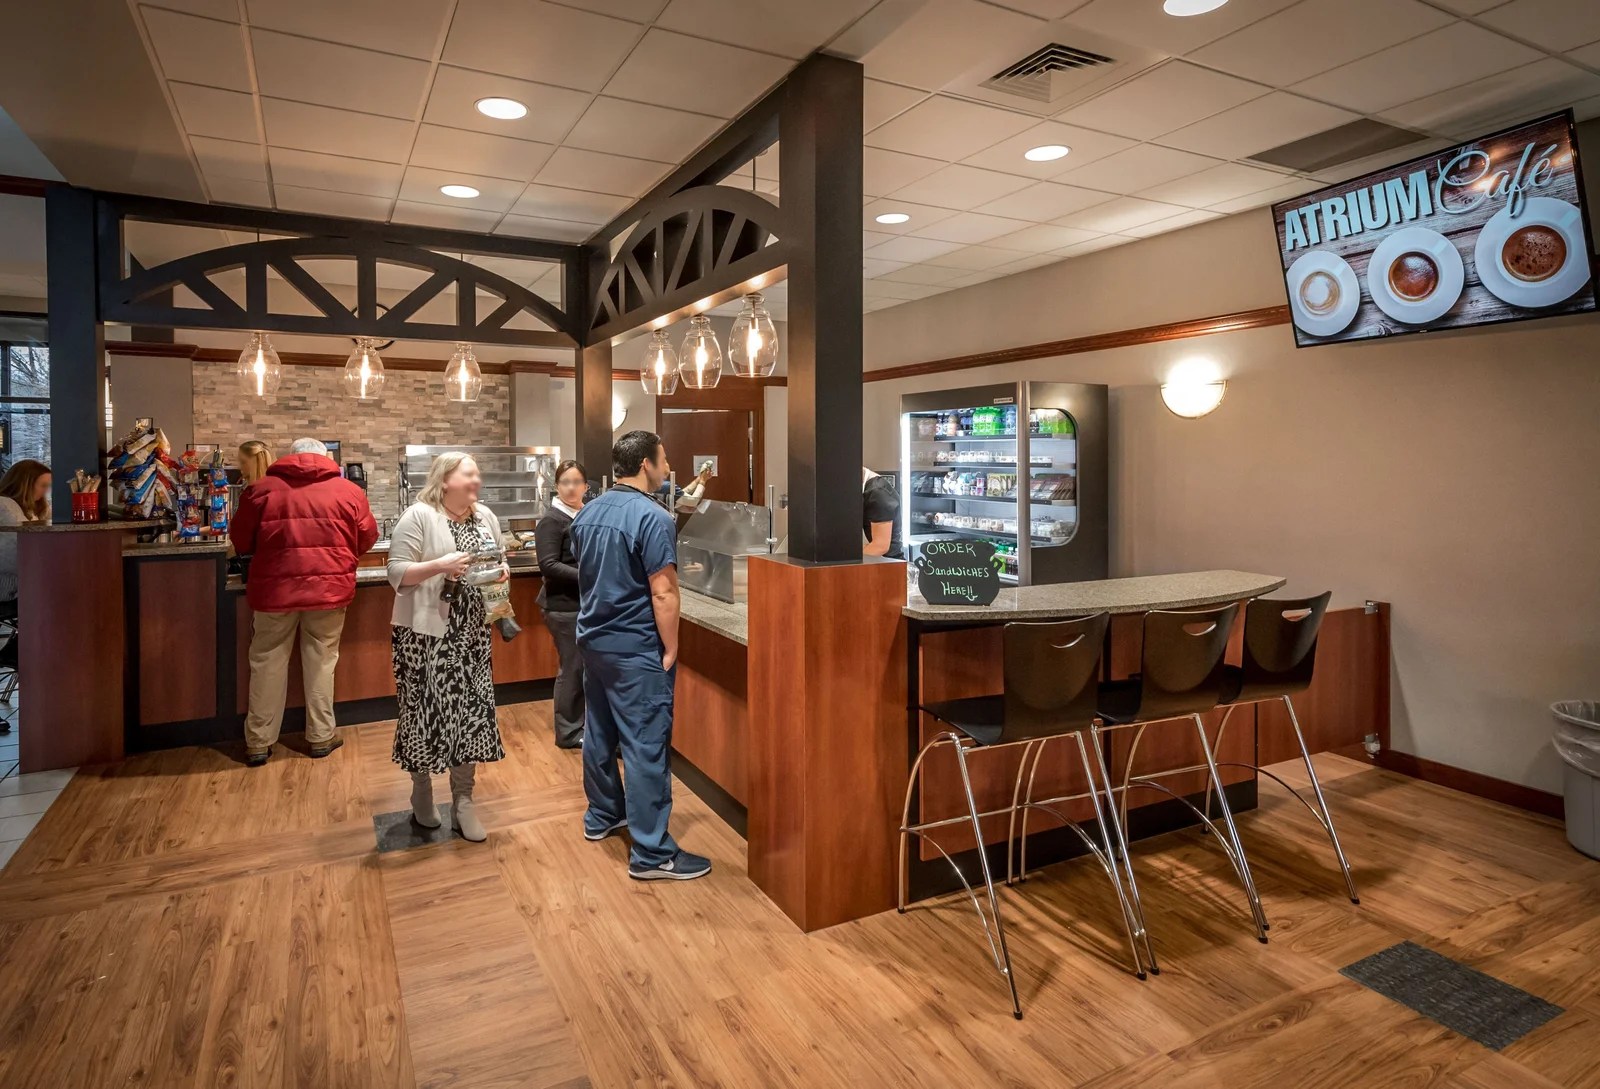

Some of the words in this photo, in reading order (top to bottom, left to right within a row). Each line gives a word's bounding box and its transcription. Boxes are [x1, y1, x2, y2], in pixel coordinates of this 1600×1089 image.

[1285, 169, 1433, 251] ATRIUM
[1435, 142, 1558, 218] Café
[926, 542, 977, 557] ORDER
